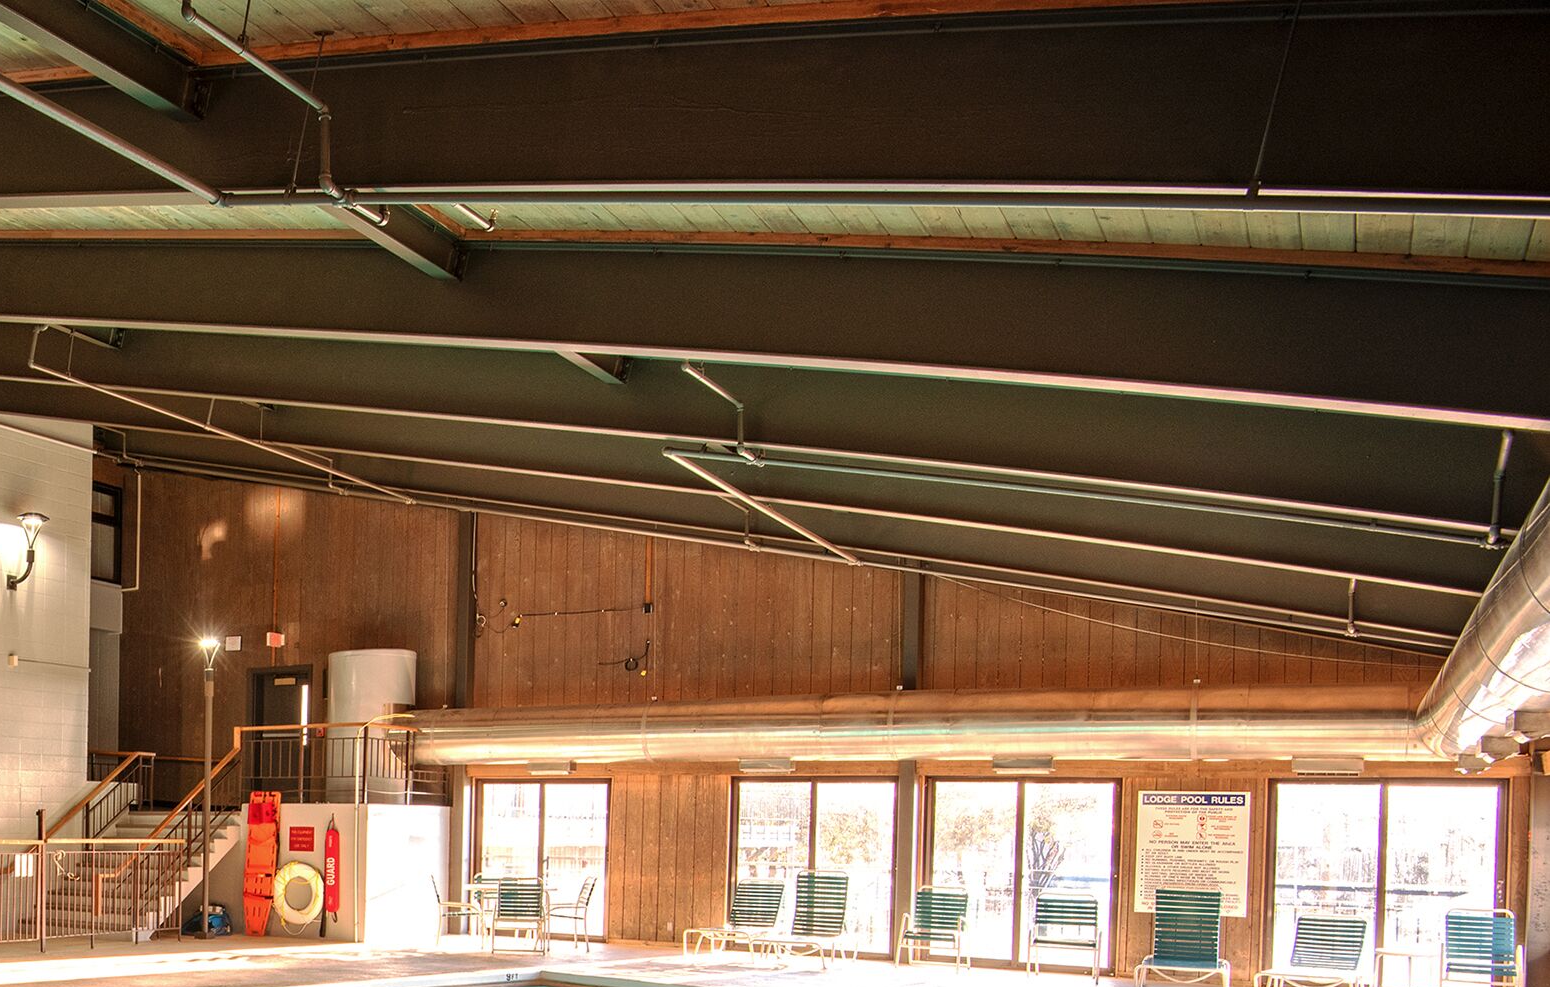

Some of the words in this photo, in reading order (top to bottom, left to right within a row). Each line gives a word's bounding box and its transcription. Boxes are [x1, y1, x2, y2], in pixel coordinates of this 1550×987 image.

[1144, 795, 1177, 804] LODGE
[1180, 795, 1208, 804] POOL
[1211, 796, 1244, 805] RULES
[326, 857, 335, 886] GUARD
